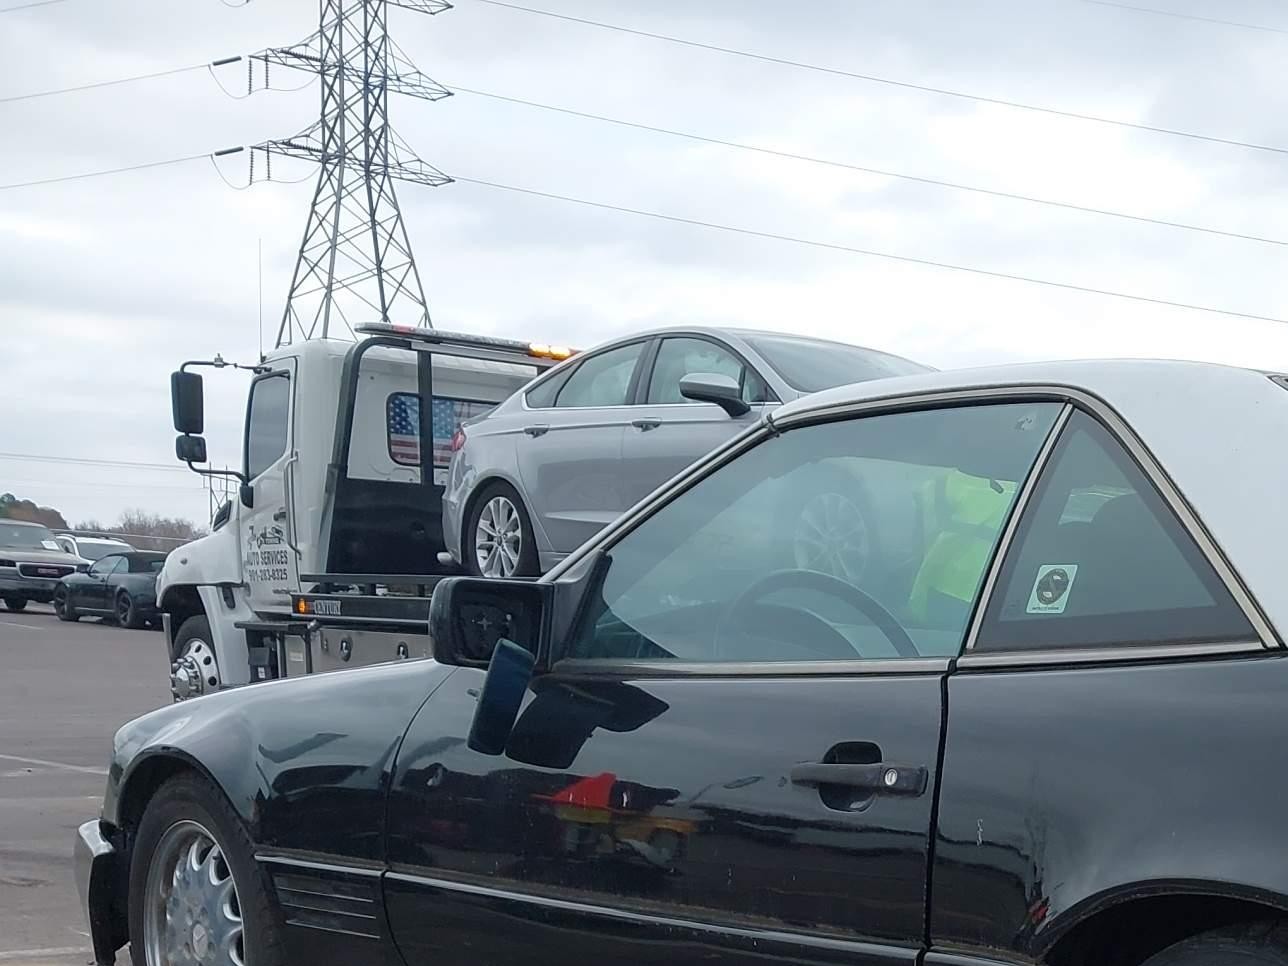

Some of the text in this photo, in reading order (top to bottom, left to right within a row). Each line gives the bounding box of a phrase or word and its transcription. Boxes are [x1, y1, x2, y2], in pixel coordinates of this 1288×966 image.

[247, 550, 287, 566] AUTO SERVICES
[314, 599, 341, 615] CENTURY
